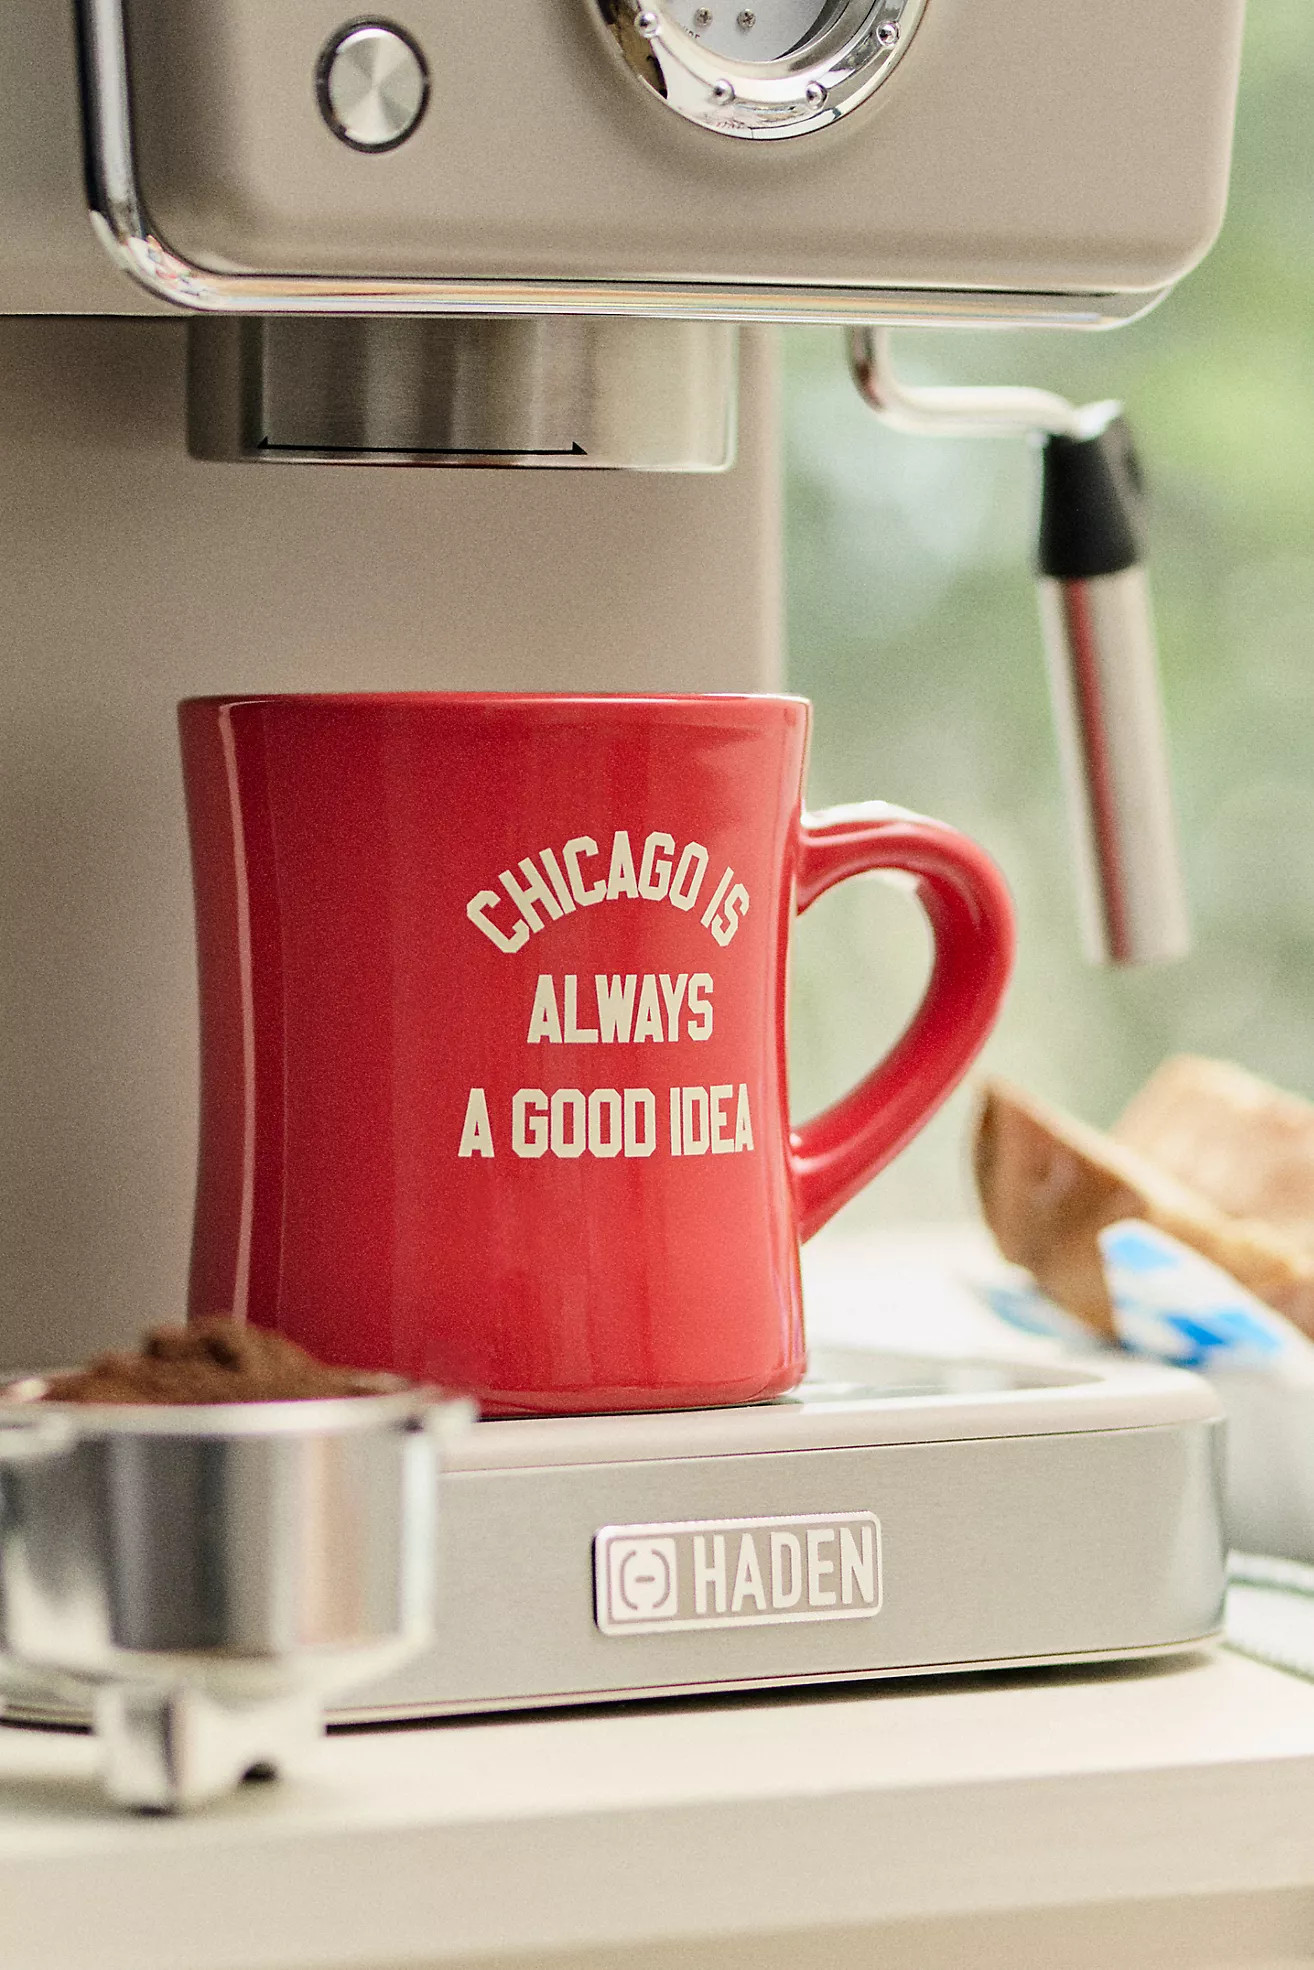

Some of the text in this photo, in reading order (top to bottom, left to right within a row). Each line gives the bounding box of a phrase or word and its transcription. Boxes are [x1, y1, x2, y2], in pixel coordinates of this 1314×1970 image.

[467, 830, 750, 954] CHICAGO IS
[527, 973, 714, 1043] ALWAYS
[458, 1083, 754, 1158] A GOOD IDEA
[693, 1526, 874, 1614] HADEN
